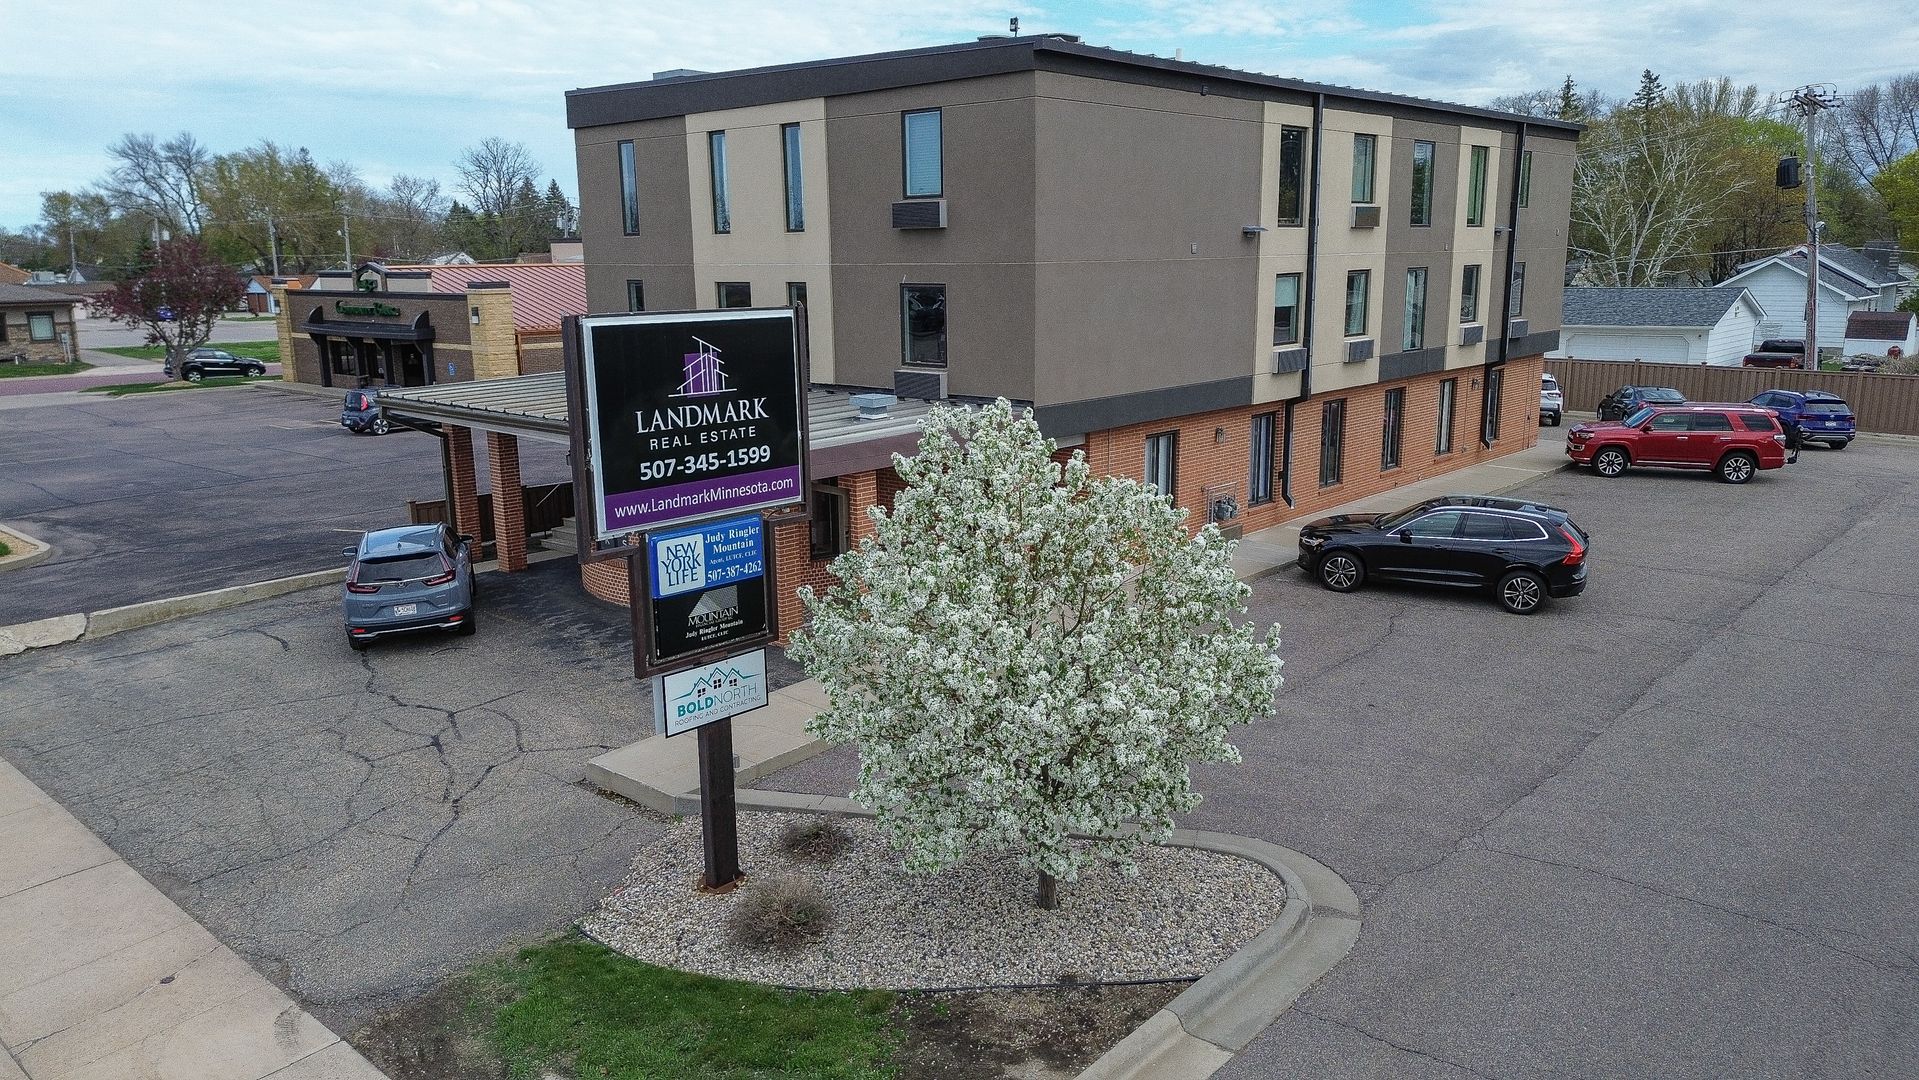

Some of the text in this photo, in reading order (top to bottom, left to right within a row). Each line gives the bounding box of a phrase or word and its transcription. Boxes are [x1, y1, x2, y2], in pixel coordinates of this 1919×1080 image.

[635, 397, 769, 434] LANDMARK
[649, 426, 757, 451] REAL ESTATE
[640, 444, 771, 481] 507-345-1599
[615, 476, 793, 518] www.LandmarkMinnesota.com
[705, 525, 760, 544] Judy Ringler
[666, 540, 698, 561] NEW
[713, 538, 754, 555] Mountain
[661, 553, 702, 574] YORK
[707, 560, 762, 583] 507-387-4262
[668, 568, 699, 587] LIFE
[687, 605, 739, 627] MOUNTAIN
[699, 625, 718, 635] Ringler
[719, 619, 744, 630] Mountain
[674, 695, 762, 727] ROOFING AND CONTRACTING
